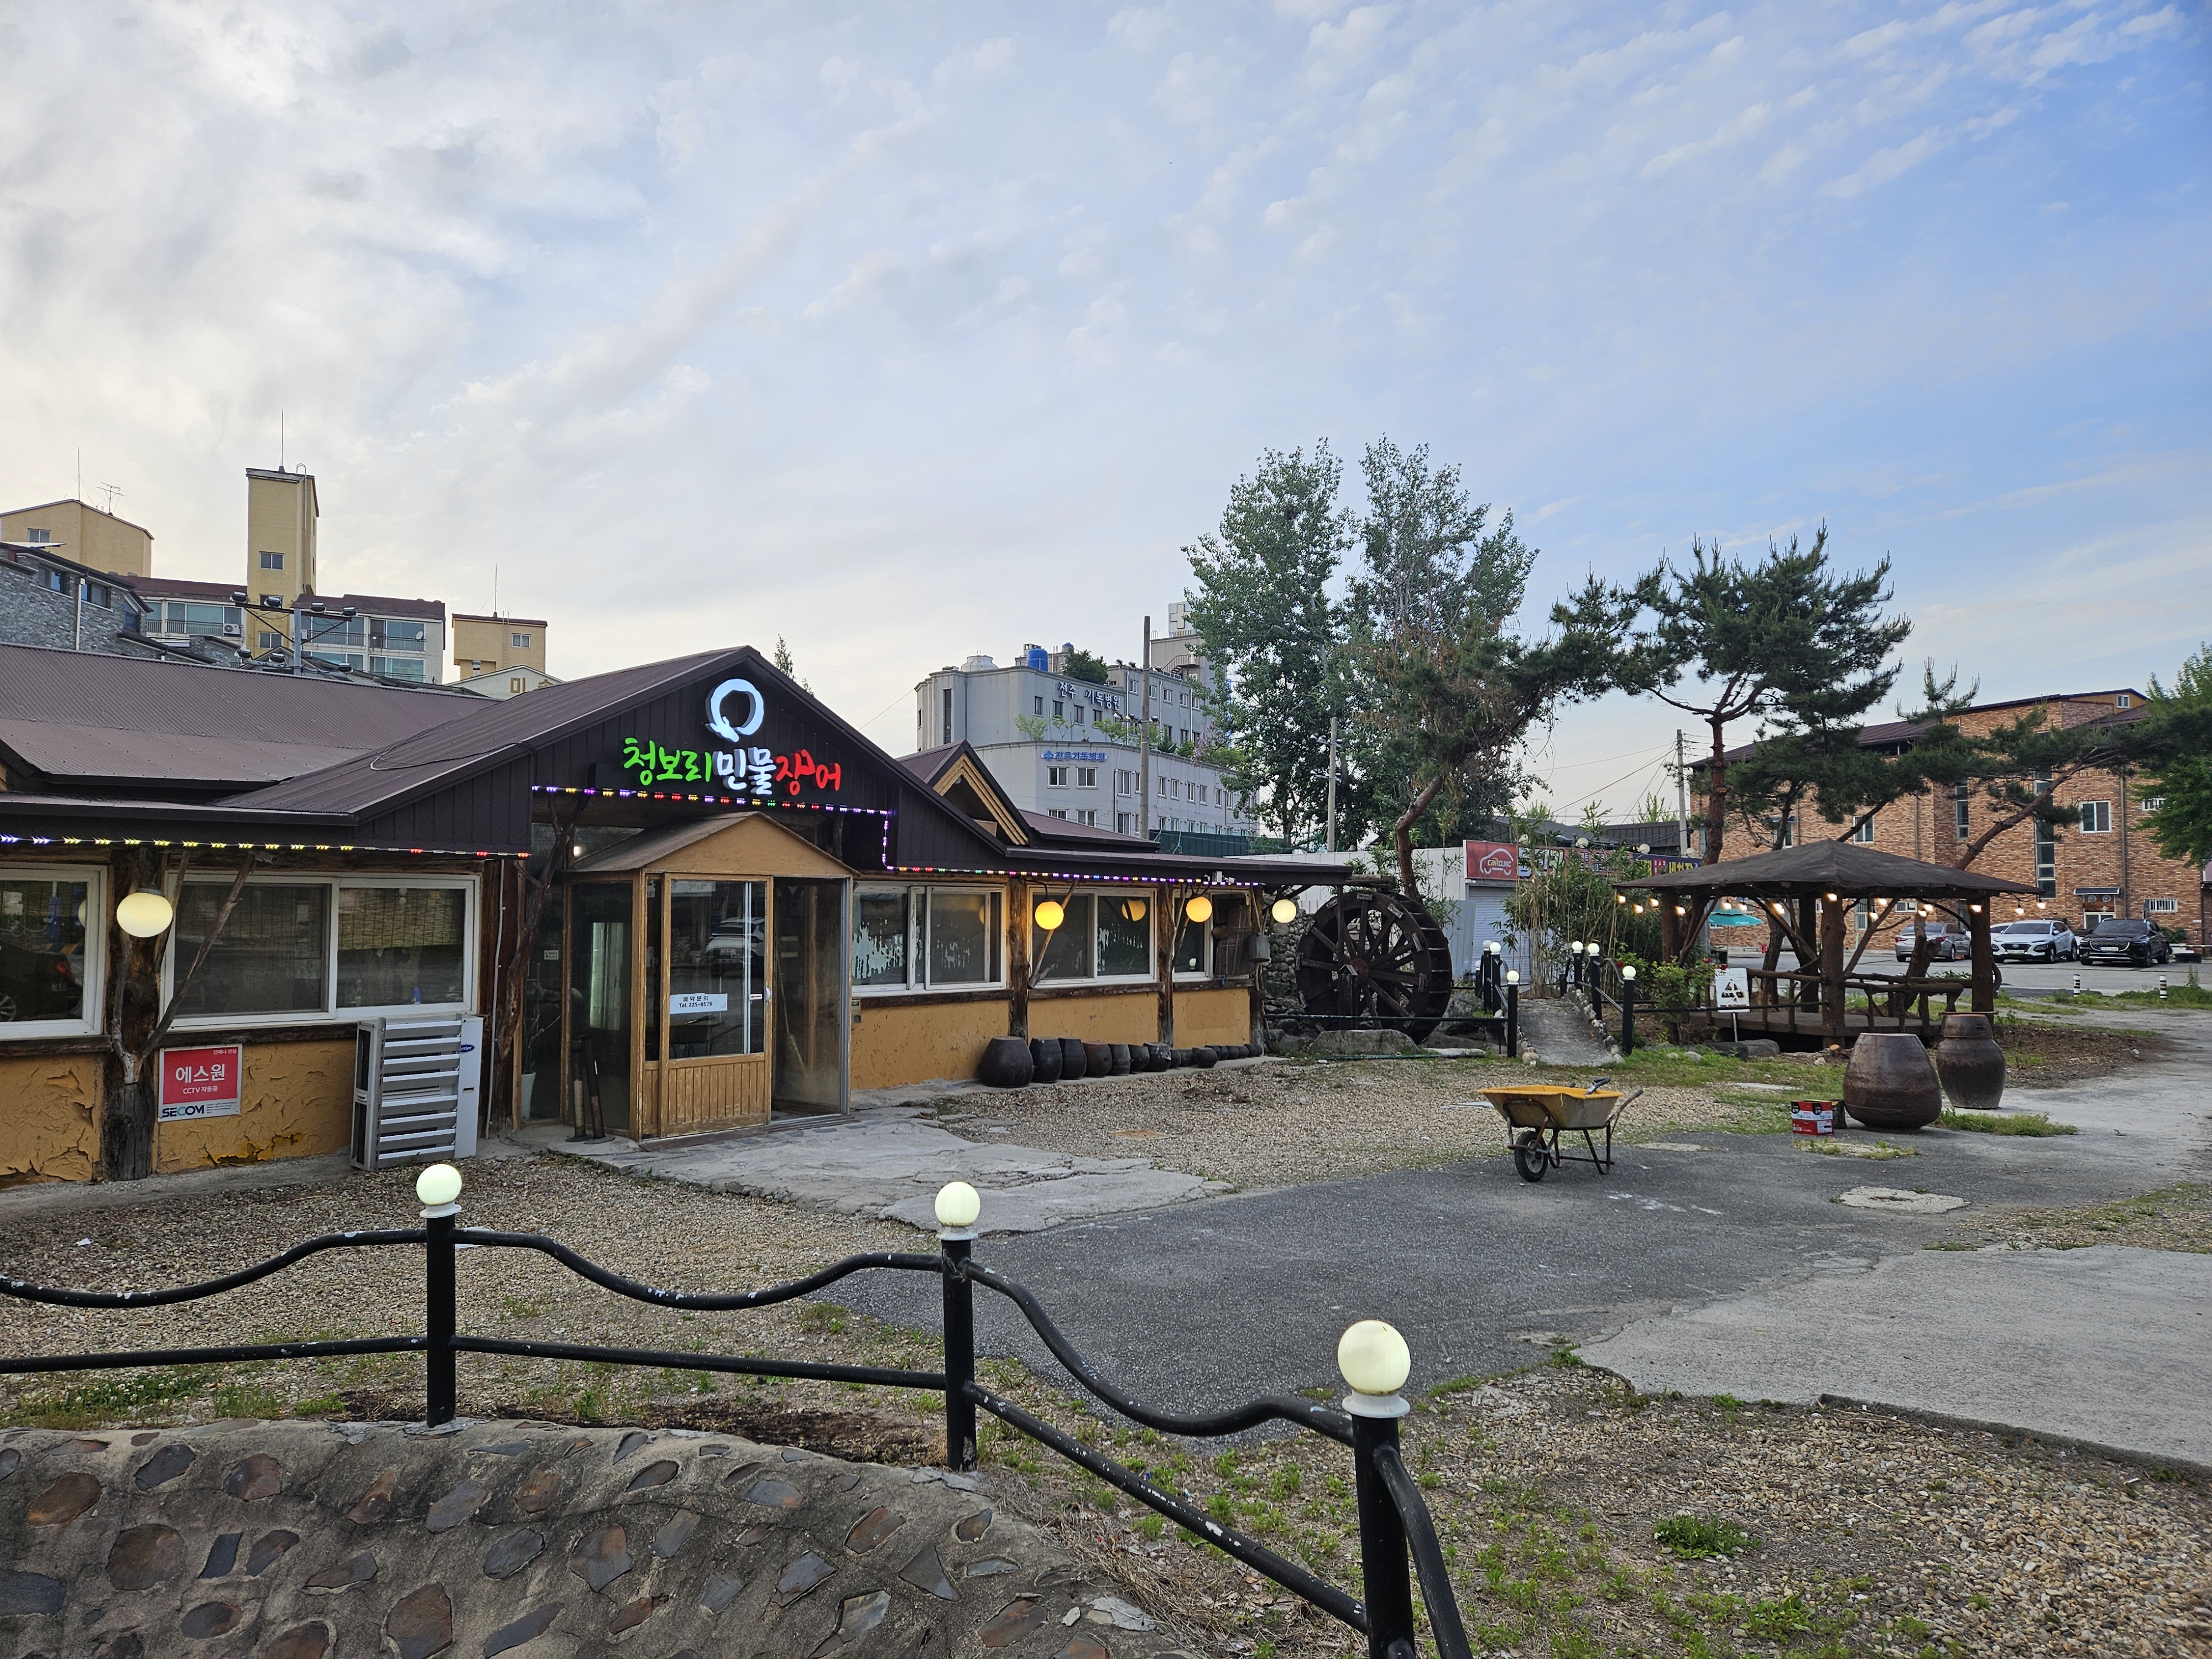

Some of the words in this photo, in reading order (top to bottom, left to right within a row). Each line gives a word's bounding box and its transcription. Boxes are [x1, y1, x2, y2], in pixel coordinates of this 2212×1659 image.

[1058, 681, 1077, 699] 전주
[1085, 688, 1120, 711] 기독병원
[1056, 751, 1105, 762] 전주기독병원
[175, 1063, 225, 1083] 에스원
[162, 1104, 205, 1118] SECOM
